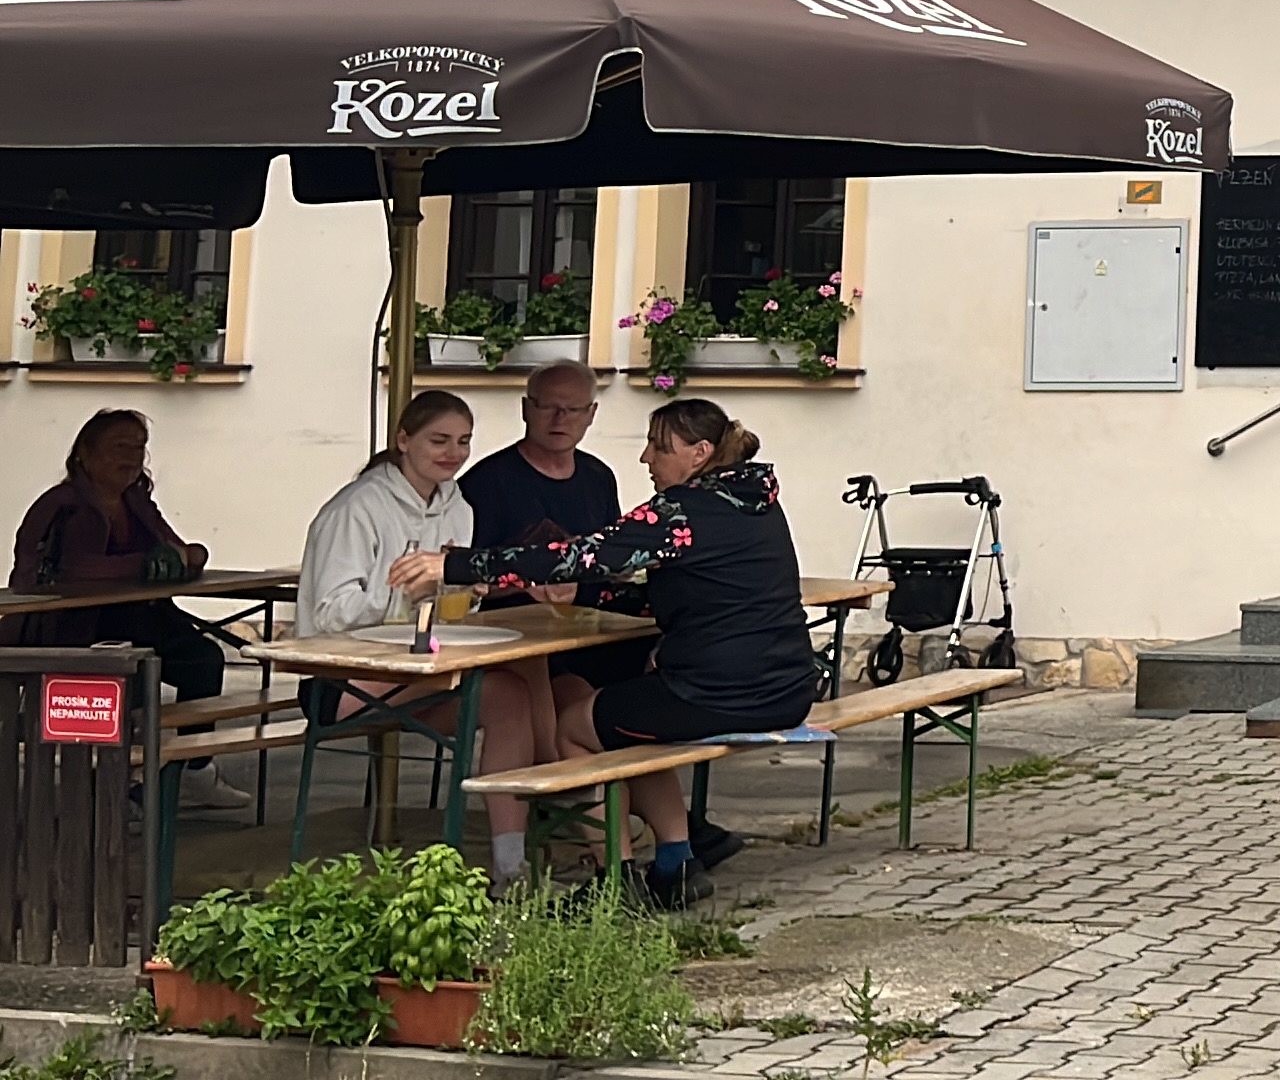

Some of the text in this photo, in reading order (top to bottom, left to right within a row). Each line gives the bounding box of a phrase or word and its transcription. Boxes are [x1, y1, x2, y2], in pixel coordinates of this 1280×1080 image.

[340, 46, 505, 72] VELKOPOPOVICKÝ
[407, 61, 440, 72] 1874
[327, 79, 501, 138] Kozel
[1145, 119, 1203, 163] Kozel
[92, 697, 112, 708] ZDE
[50, 709, 110, 721] NEPARKUJTE
